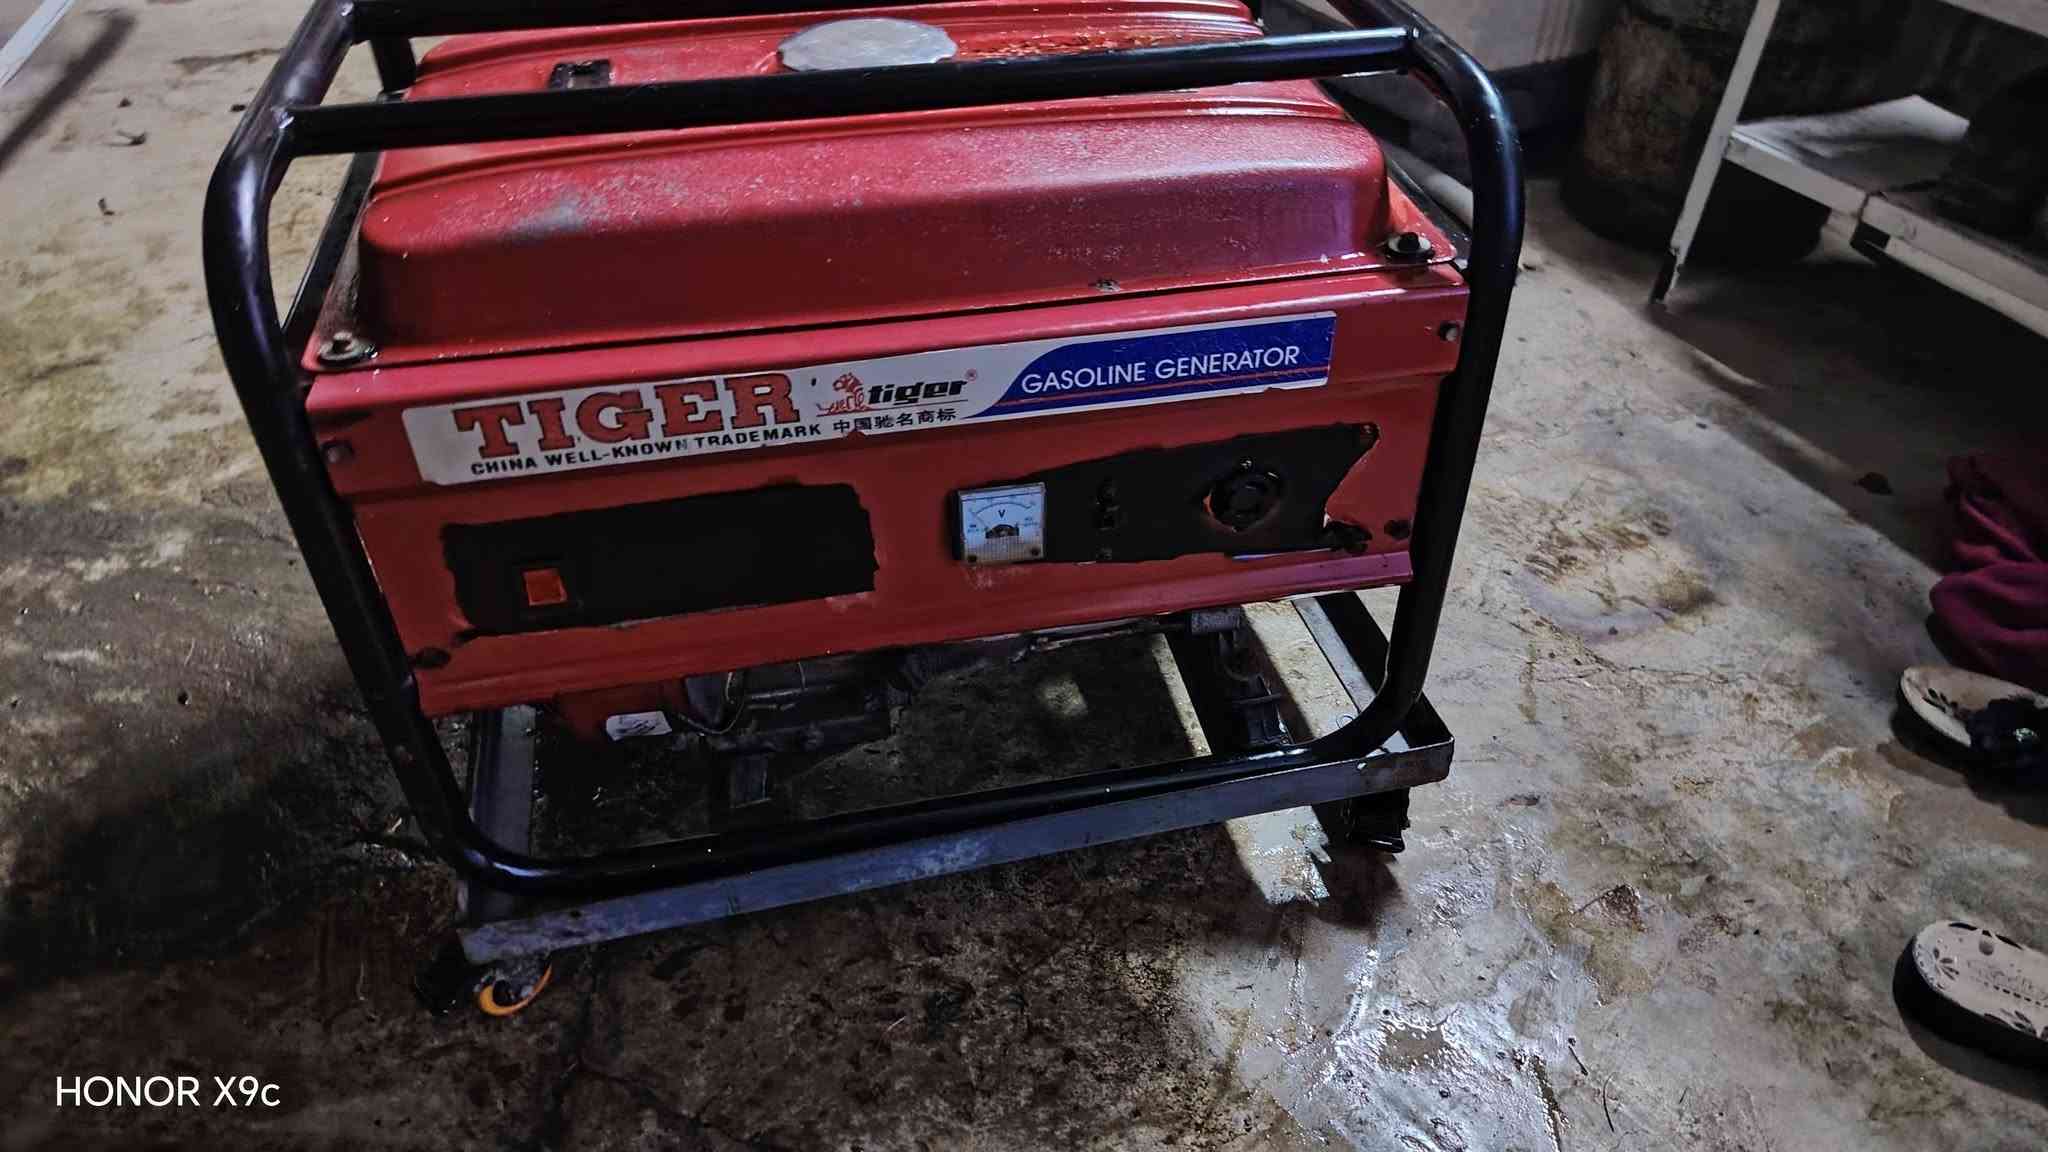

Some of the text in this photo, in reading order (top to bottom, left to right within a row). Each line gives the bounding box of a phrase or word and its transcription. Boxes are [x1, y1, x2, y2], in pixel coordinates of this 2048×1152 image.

[1021, 345, 1300, 395] GASOLINE GENERATOR
[868, 380, 968, 405] tiger
[453, 372, 800, 459] TIGER
[833, 408, 957, 434] 中国驰名商标
[471, 423, 821, 476] CHINA WELL-KNOWN TRADEMARK
[998, 509, 1006, 519] V
